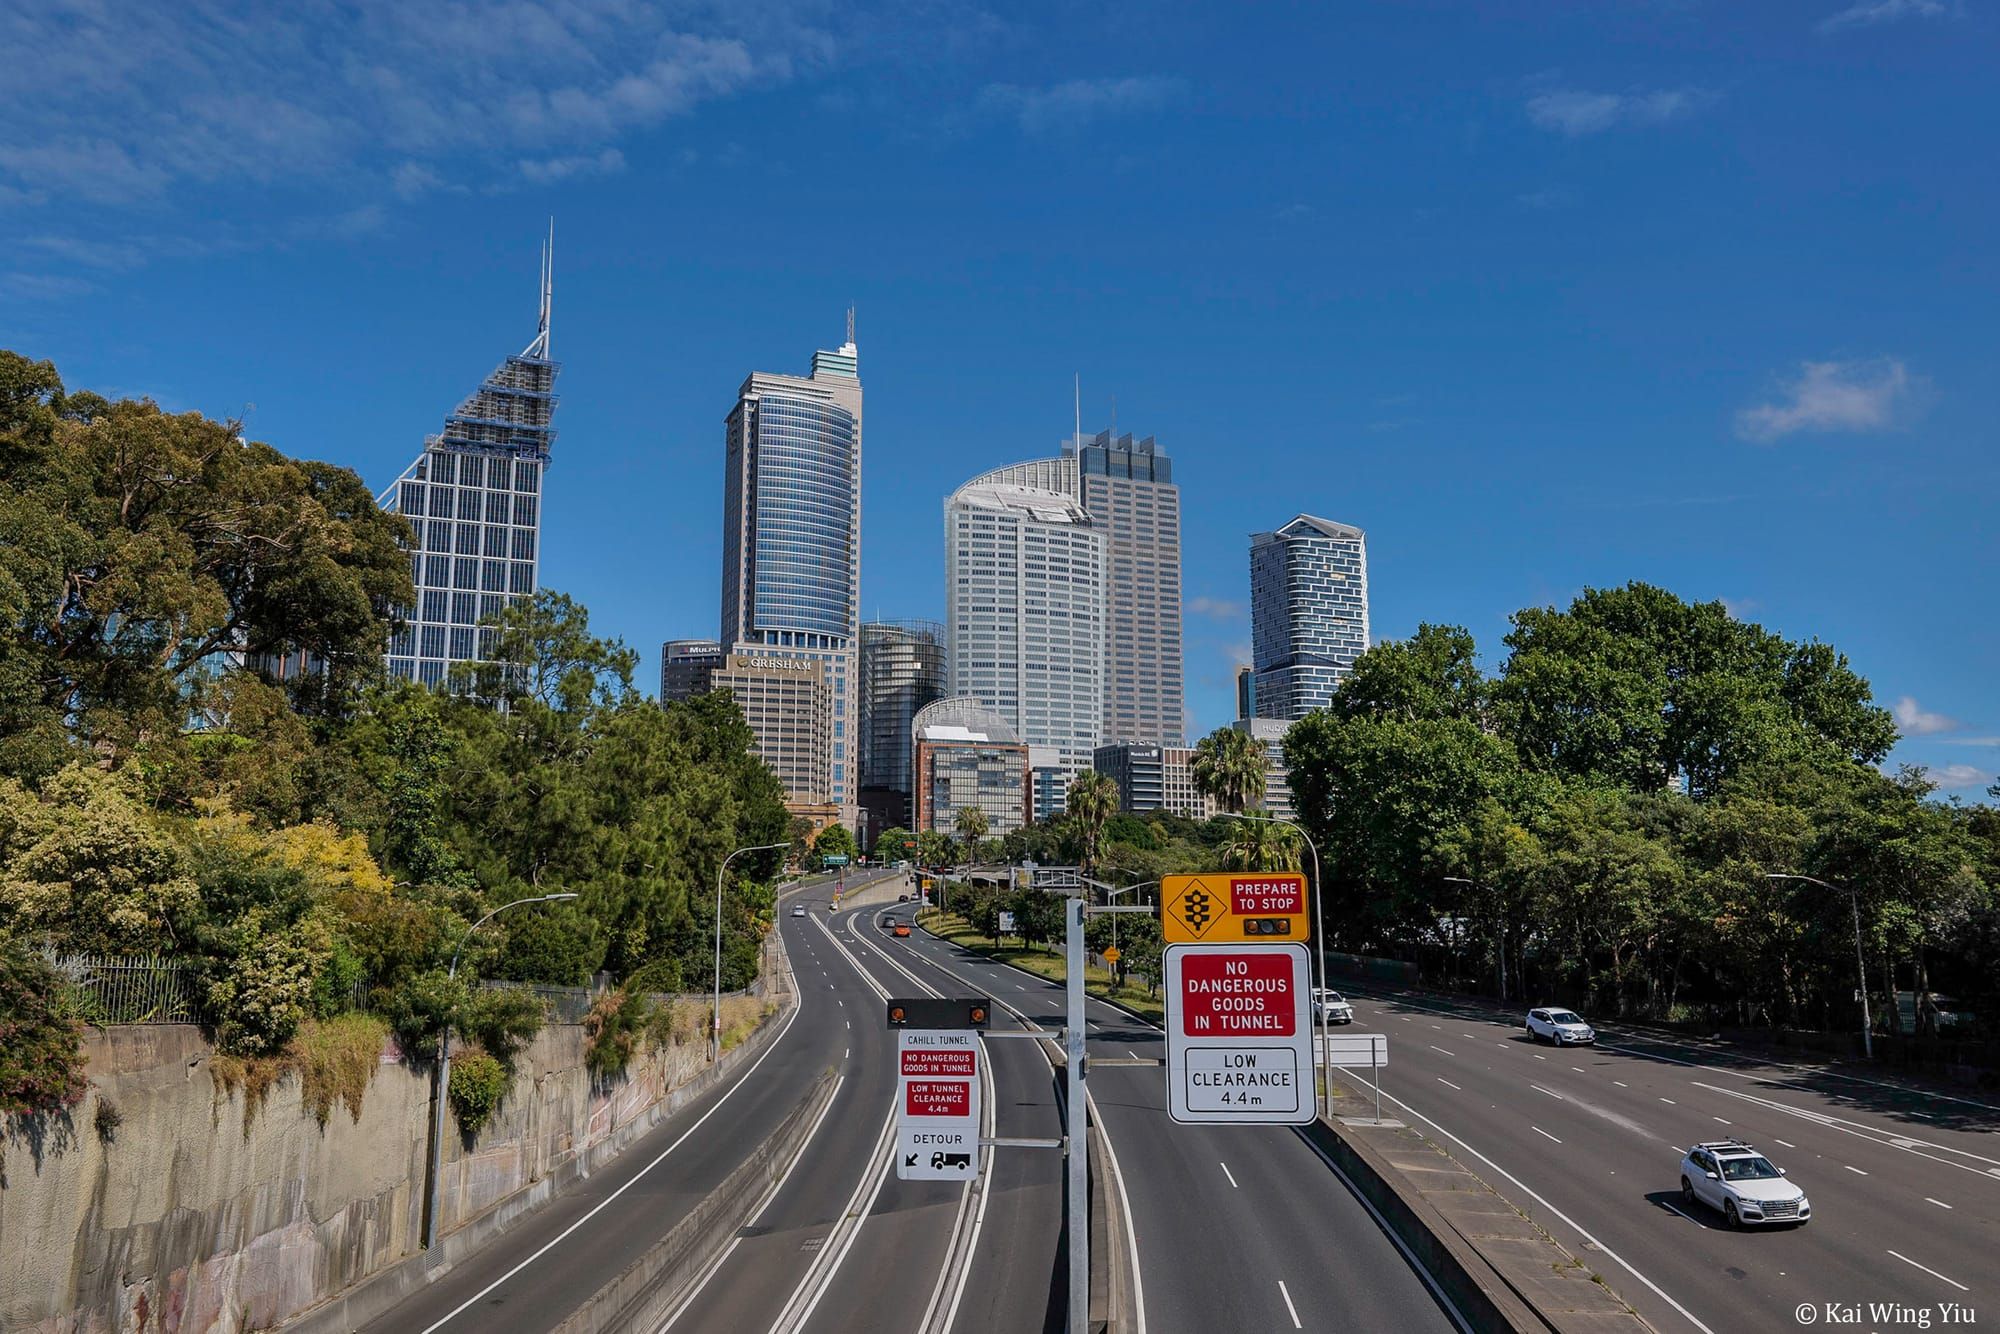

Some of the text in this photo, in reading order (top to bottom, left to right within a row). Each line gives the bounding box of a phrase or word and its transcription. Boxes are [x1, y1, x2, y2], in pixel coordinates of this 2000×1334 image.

[751, 658, 812, 670] GRESHAM
[1236, 883, 1297, 895] PREPARE
[1240, 898, 1294, 910] TO STOP
[1226, 961, 1248, 976] NO
[1189, 979, 1287, 993] DANGEROUS
[1212, 998, 1265, 1011] GOODS
[1195, 1015, 1283, 1029] IN TUNNEL
[908, 1036, 969, 1045] CAHILL TUNNEL
[1224, 1055, 1256, 1068] LOW
[942, 1064, 972, 1072] TUNNEL
[1193, 1072, 1290, 1086] CLEARANCE
[914, 1134, 962, 1144] DETOUR
